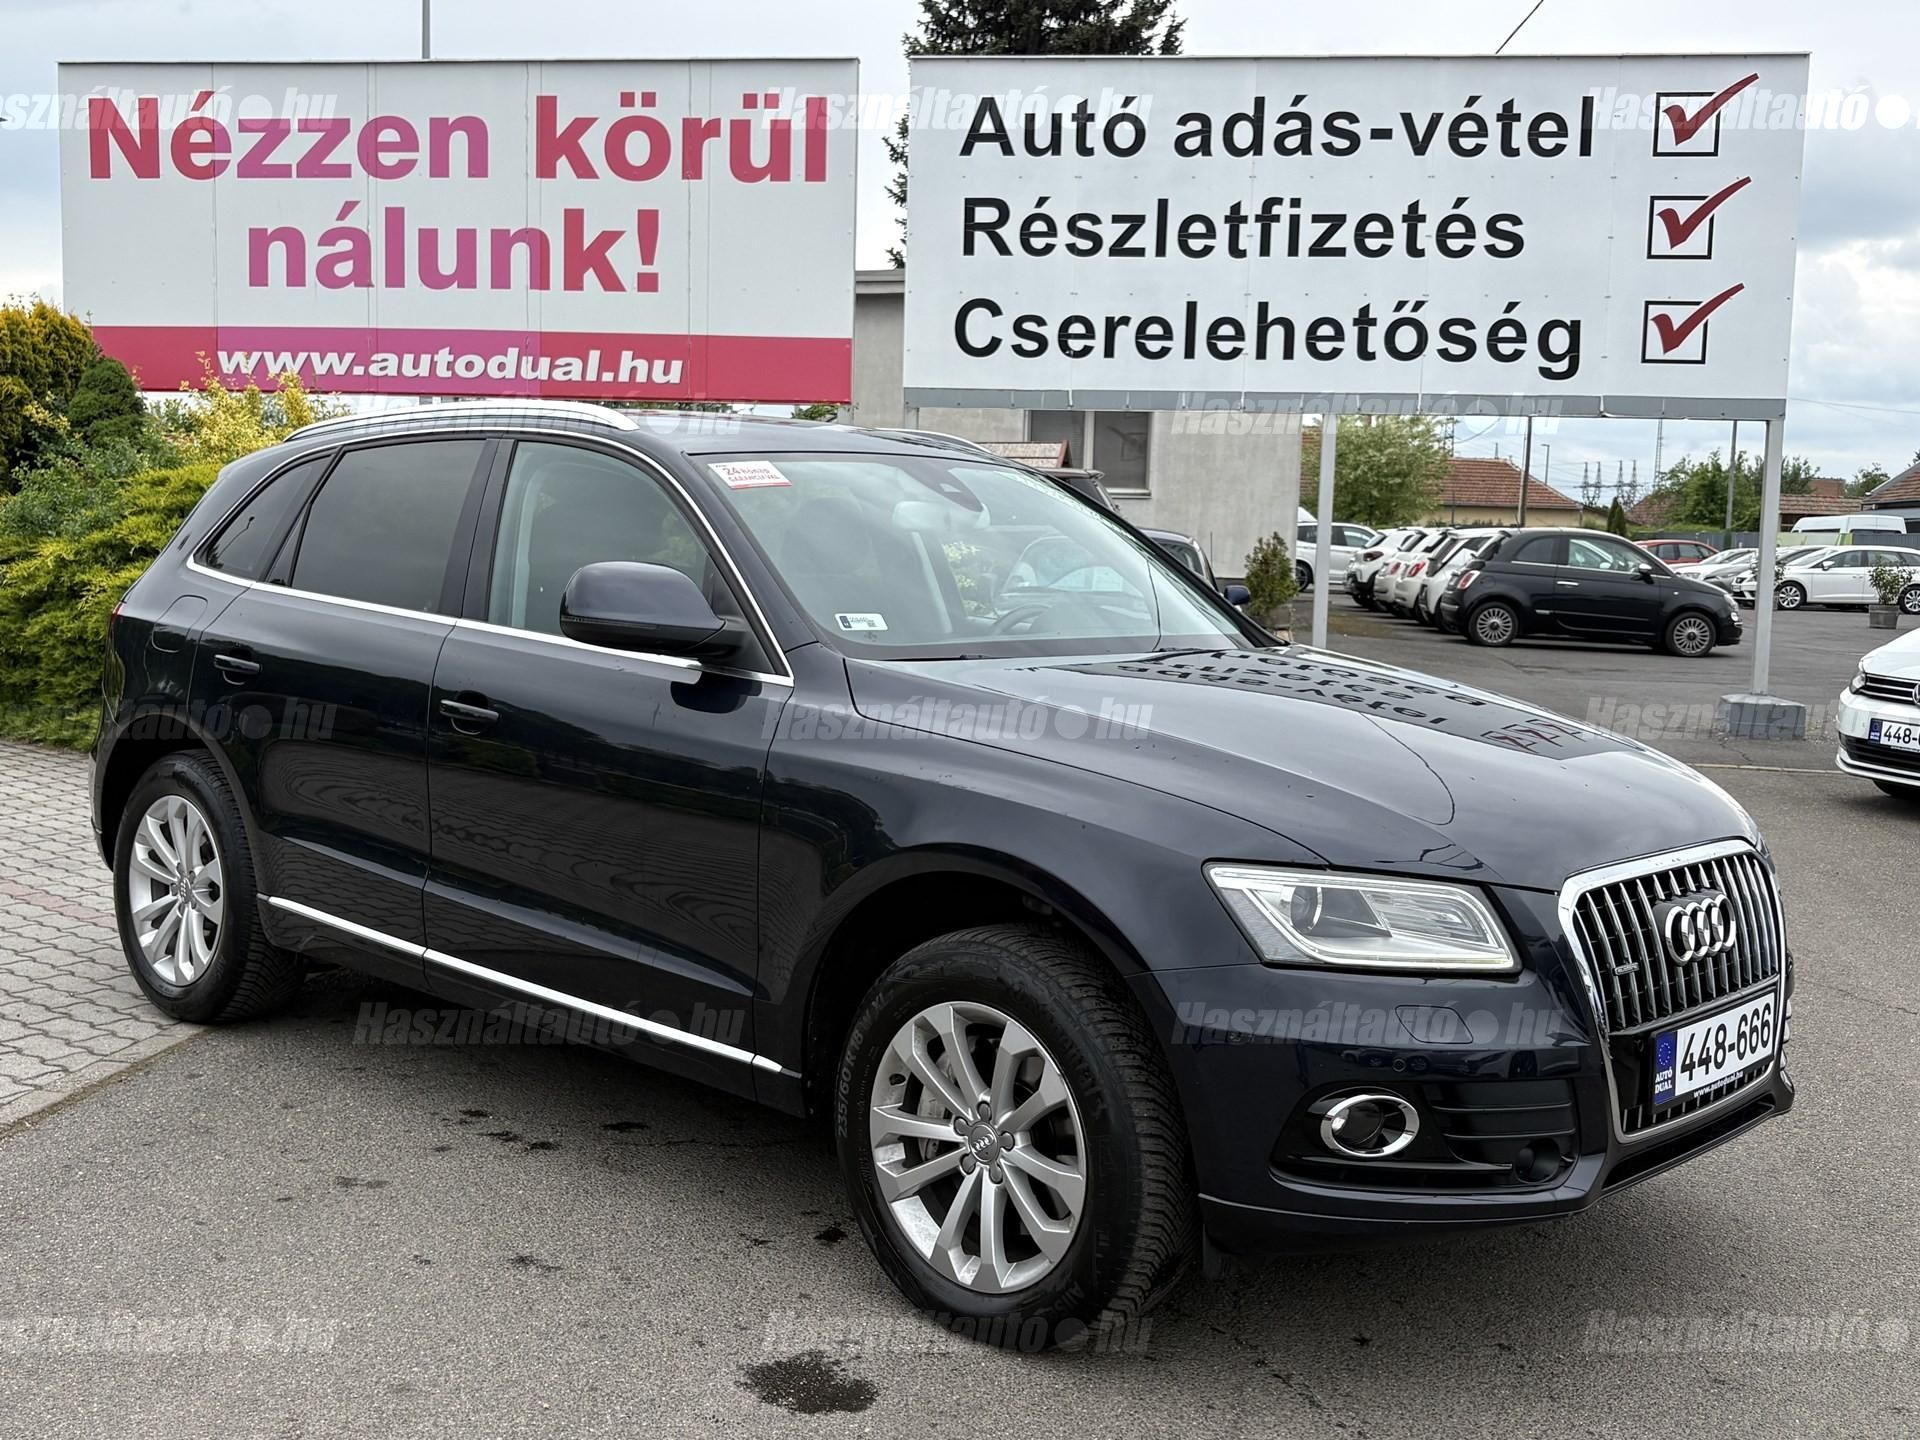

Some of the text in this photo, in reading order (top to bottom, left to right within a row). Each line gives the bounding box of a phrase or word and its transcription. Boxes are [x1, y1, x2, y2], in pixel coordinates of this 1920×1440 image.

[88, 92, 827, 183] Nézzen körül
[960, 95, 1594, 158] Autó adás-vétel
[249, 202, 659, 292] nálunk!
[963, 196, 1524, 259] Részletfizetés
[217, 347, 683, 385] www.autodual.hu
[954, 299, 1582, 381] Cserelehetőség
[1883, 724, 1920, 745] 448-
[1680, 1003, 1771, 1081] 448-666
[1655, 1066, 1673, 1083] AUTÓ
[1655, 1079, 1673, 1094] DUAL
